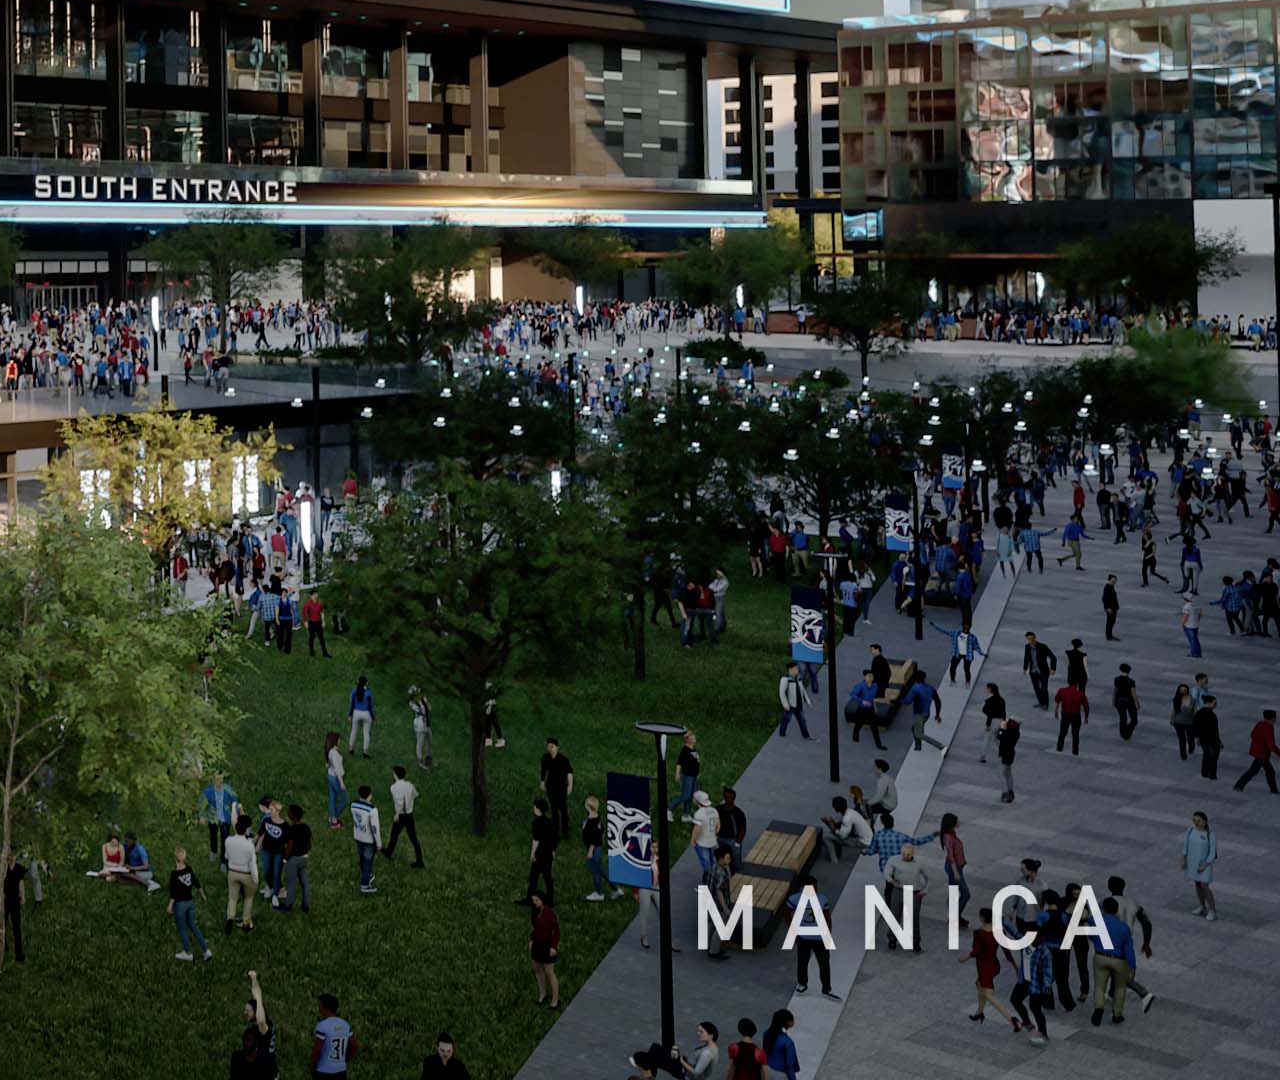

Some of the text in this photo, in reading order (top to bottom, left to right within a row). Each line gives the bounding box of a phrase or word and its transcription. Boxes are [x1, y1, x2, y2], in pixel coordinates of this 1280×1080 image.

[34, 174, 298, 203] SOUTH ENTRANCE
[329, 1037, 347, 1061] 31
